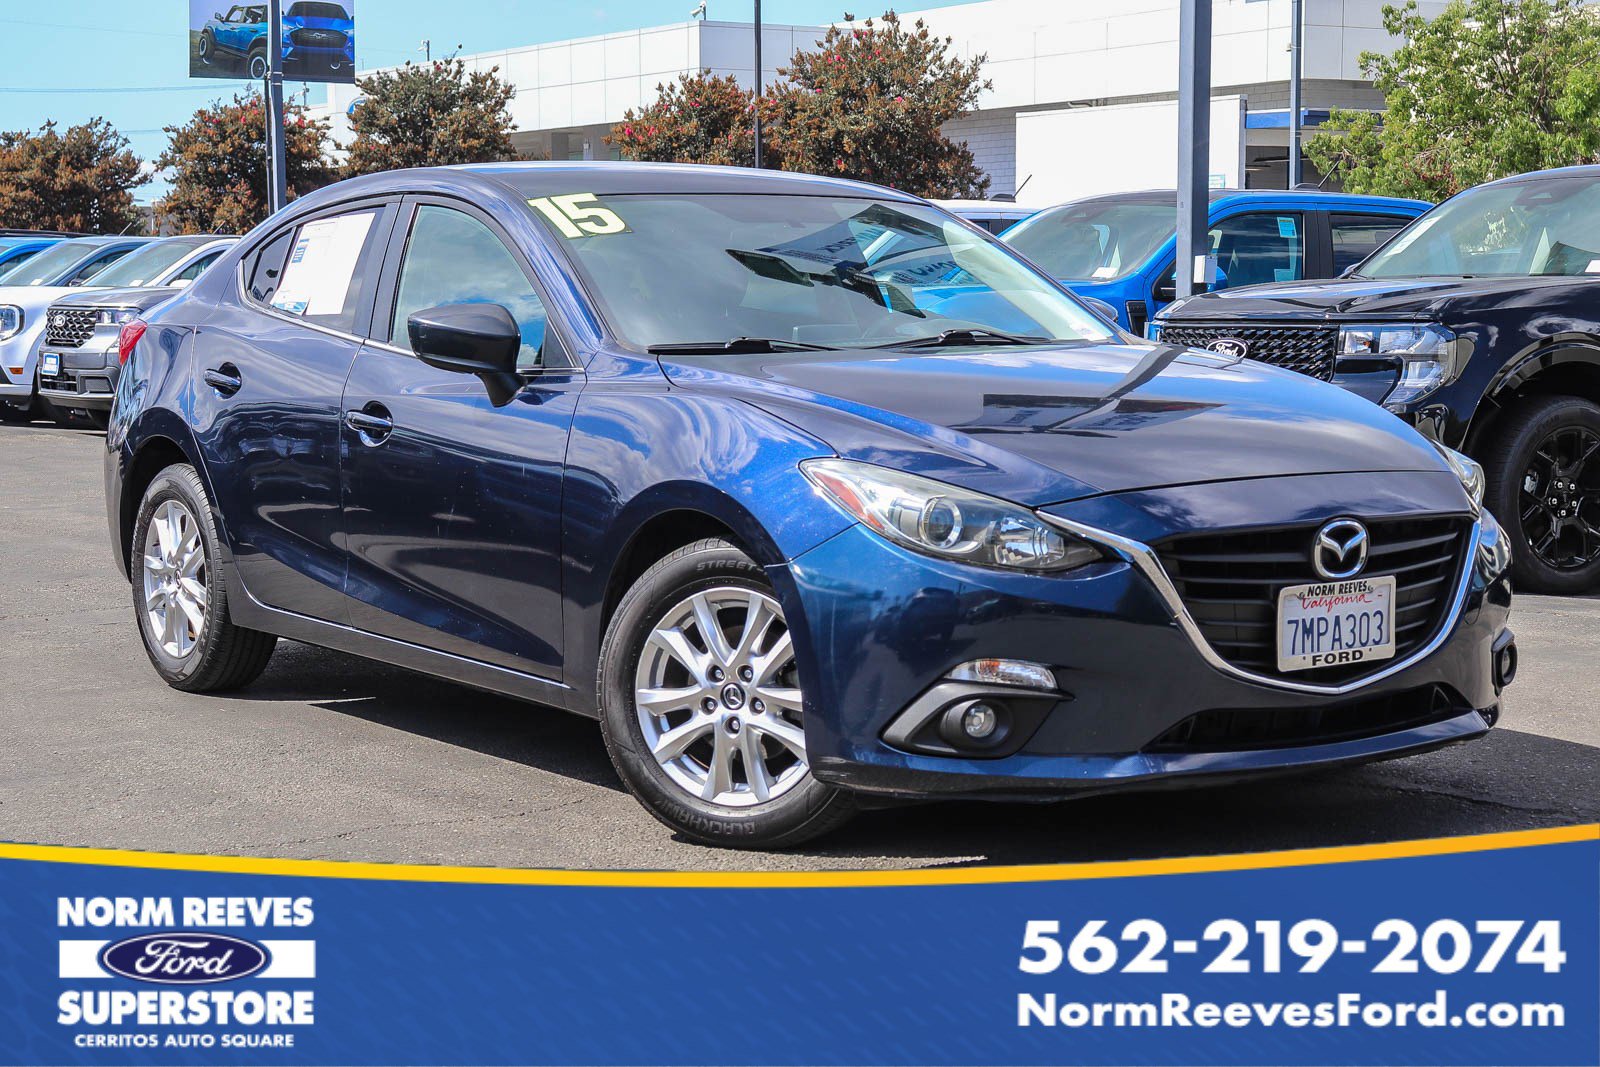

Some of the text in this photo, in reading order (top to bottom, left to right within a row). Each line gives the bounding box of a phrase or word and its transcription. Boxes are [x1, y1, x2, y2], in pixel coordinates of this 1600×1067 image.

[527, 192, 626, 239] 15
[1307, 580, 1368, 597] NORM REEVES
[1302, 593, 1373, 613] California
[1287, 609, 1384, 656] 7MPA303
[1312, 649, 1364, 666] FORD
